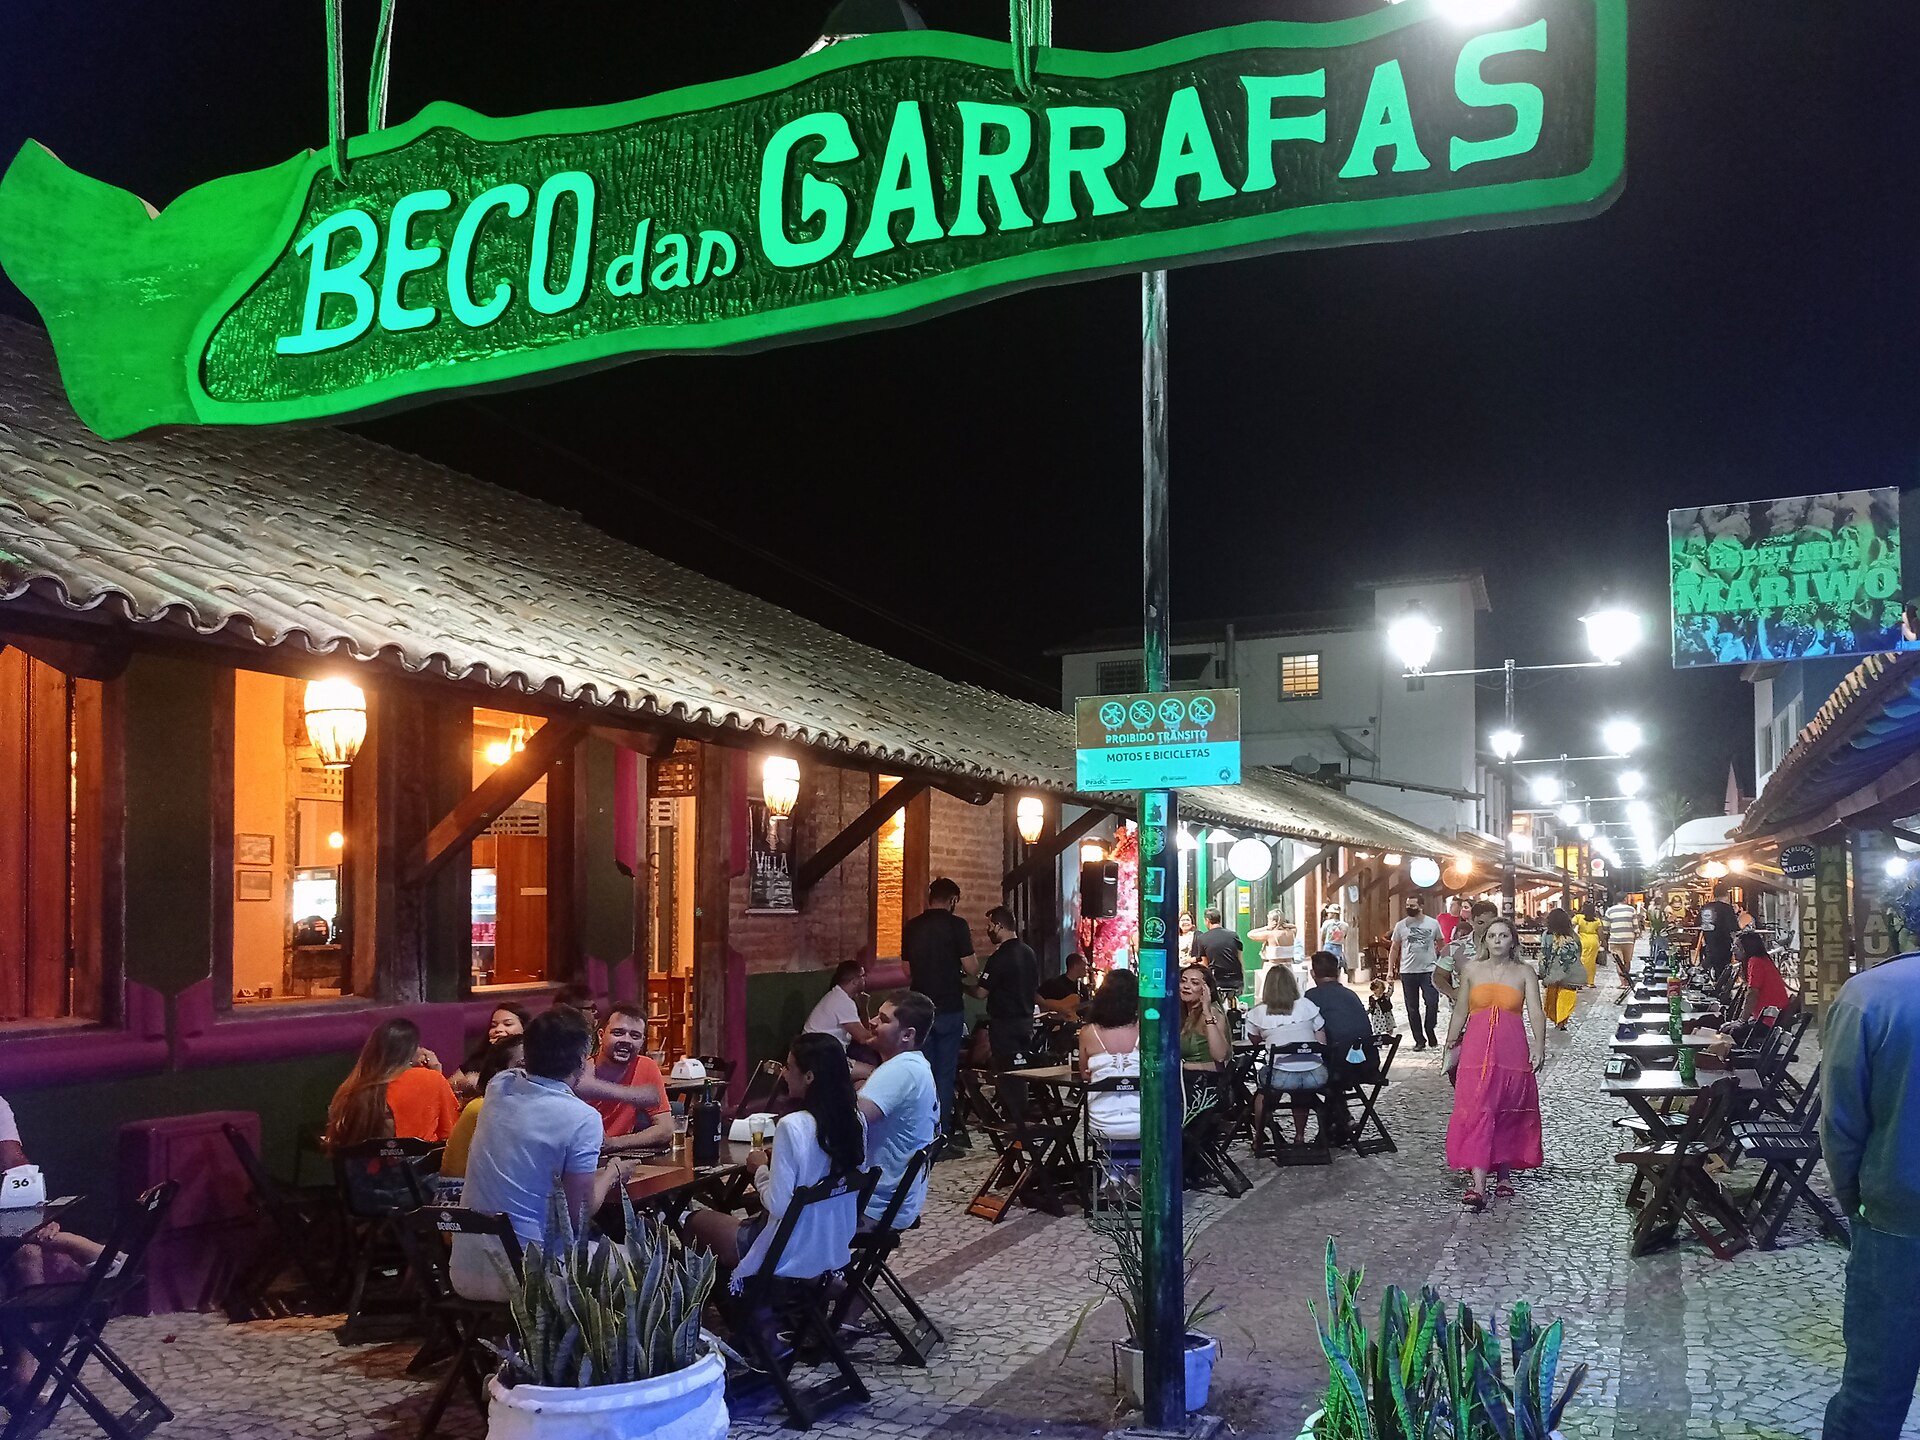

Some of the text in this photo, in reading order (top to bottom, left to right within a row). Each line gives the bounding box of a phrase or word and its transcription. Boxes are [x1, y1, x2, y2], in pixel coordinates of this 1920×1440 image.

[276, 171, 596, 355] BECO
[759, 18, 1547, 268] GARRAFAS
[1105, 732, 1155, 744] PROIBIDO
[1107, 748, 1210, 762] MOTOS E BICICLETAS
[1802, 876, 1819, 1005] STAURANTE
[12, 1178, 29, 1189] 36
